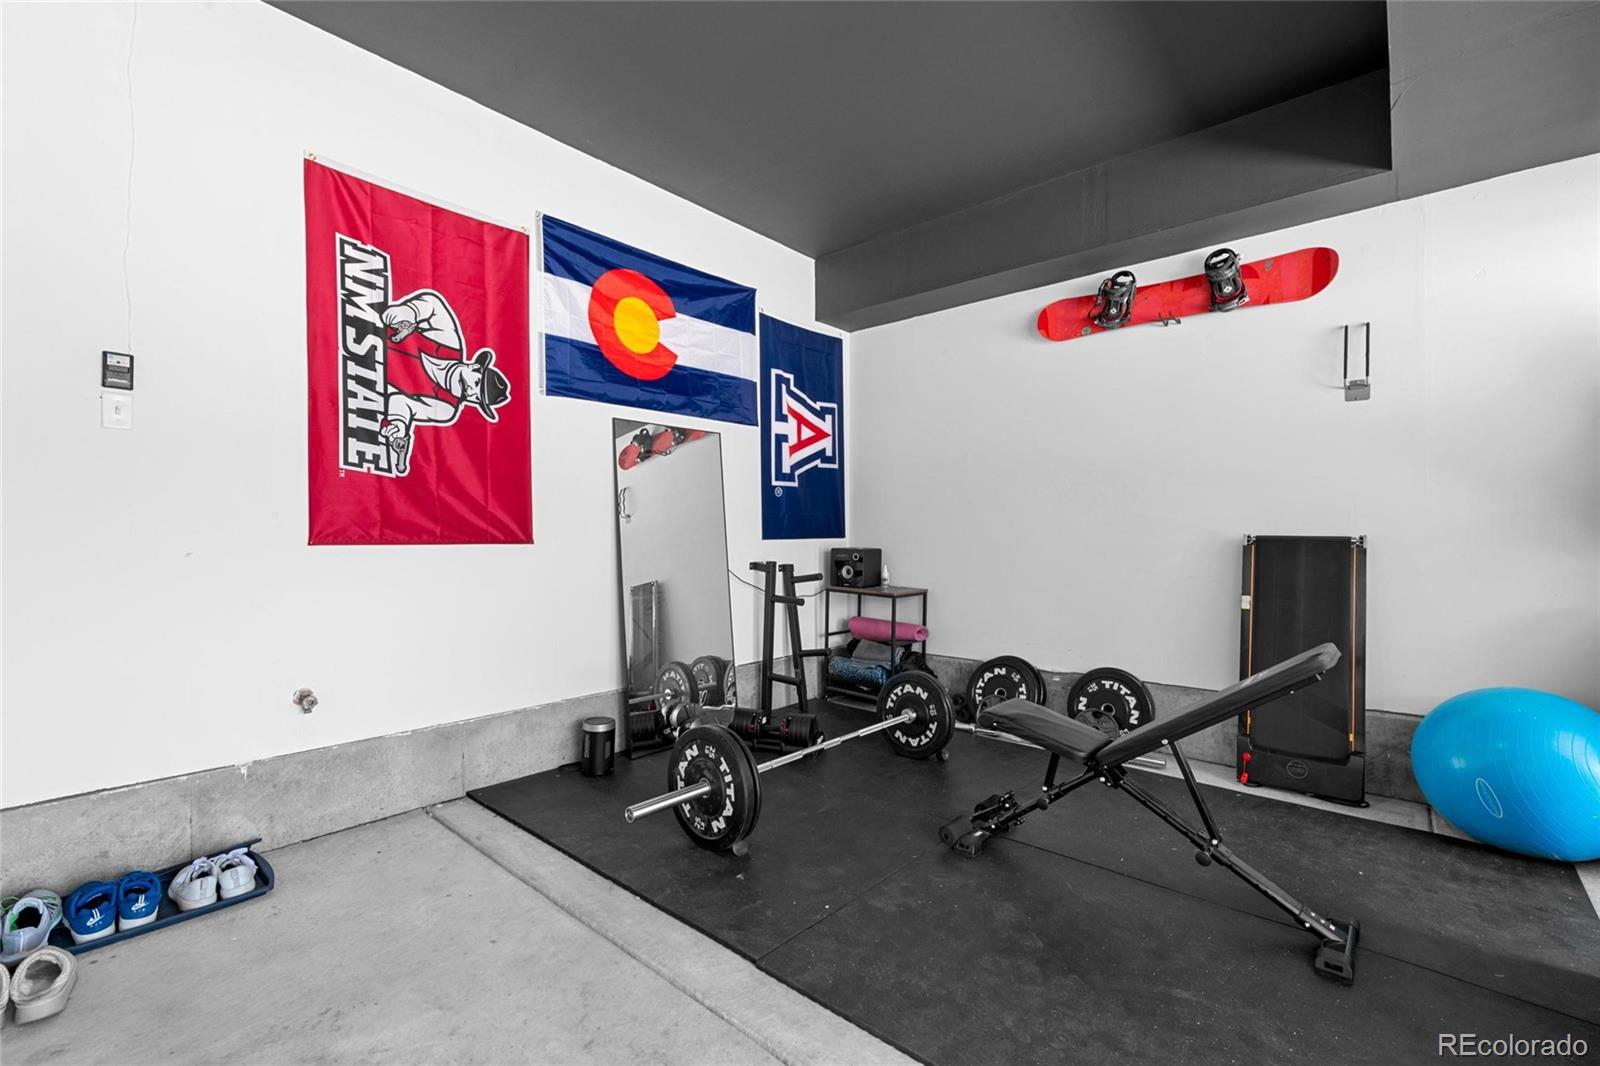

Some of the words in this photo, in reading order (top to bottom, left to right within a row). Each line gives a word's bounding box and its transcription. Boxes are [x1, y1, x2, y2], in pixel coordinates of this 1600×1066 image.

[343, 243, 385, 327] NM
[345, 325, 388, 469] STATE
[771, 368, 838, 487] A
[885, 683, 929, 710] TITAN
[975, 667, 1006, 705] TITAN
[1101, 680, 1140, 725] TITAN
[894, 721, 938, 747] TITAN
[676, 744, 700, 819] TTAN
[711, 756, 736, 834] TITAN
